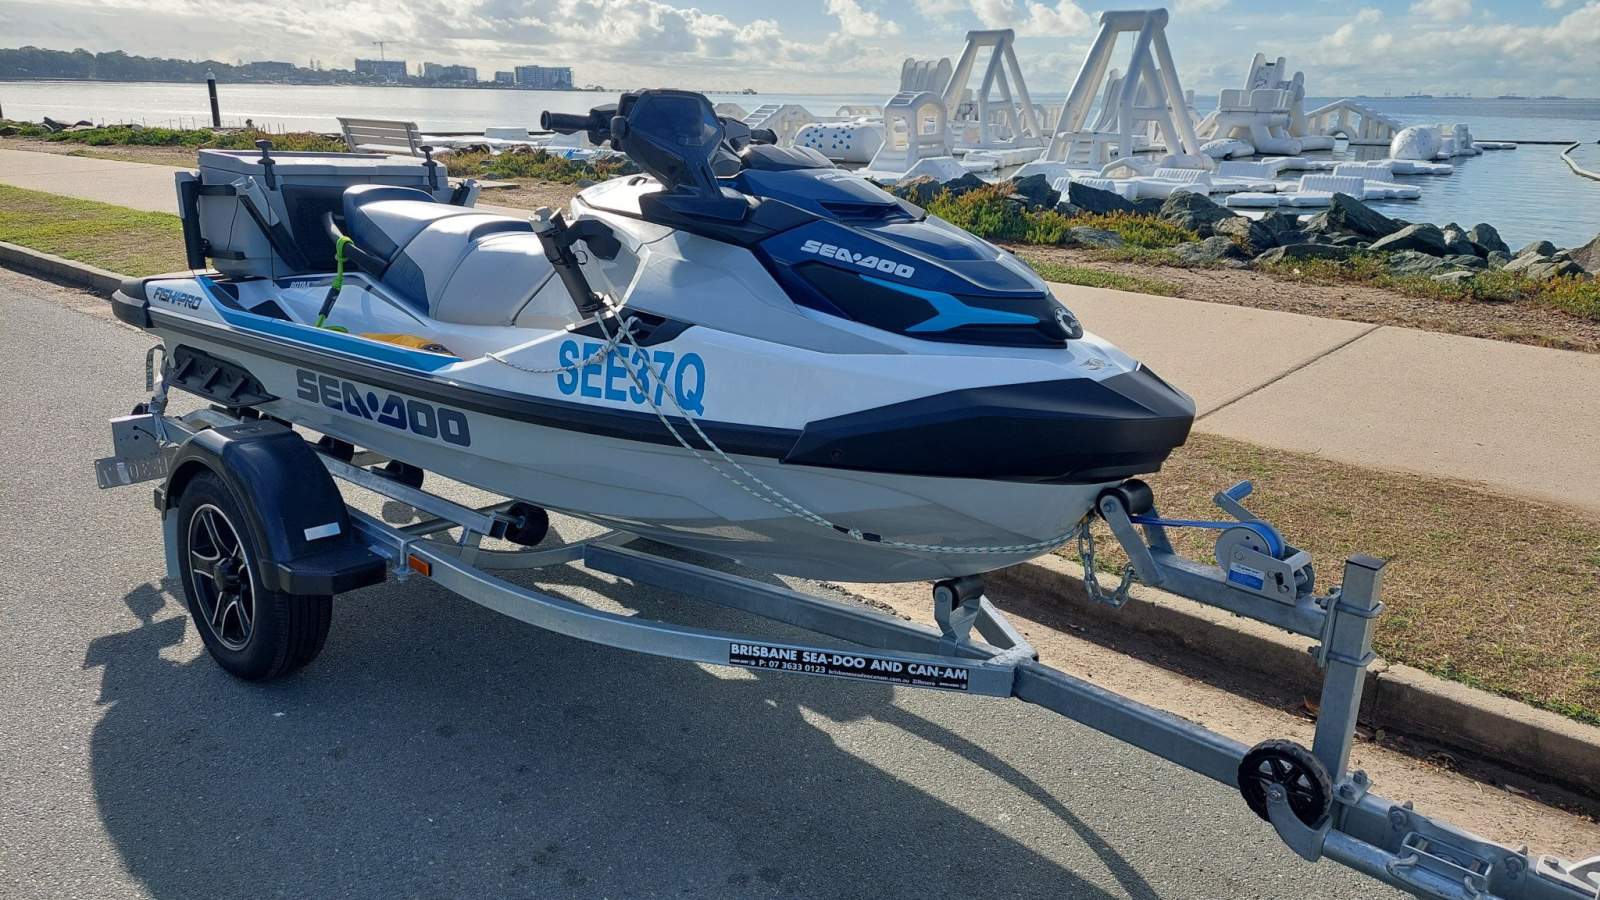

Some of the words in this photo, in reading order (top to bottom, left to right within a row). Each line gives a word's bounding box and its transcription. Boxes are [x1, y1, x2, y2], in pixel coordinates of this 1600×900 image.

[557, 339, 706, 417] SEE37Q
[731, 643, 797, 661] BRISBANE
[802, 651, 866, 669] SEA-DOO
[870, 659, 903, 673] AND
[907, 663, 968, 680] CAN-AM
[759, 659, 767, 667] P:
[769, 660, 779, 668] 07
[782, 661, 802, 671] 3633
[804, 664, 825, 673] 0123
